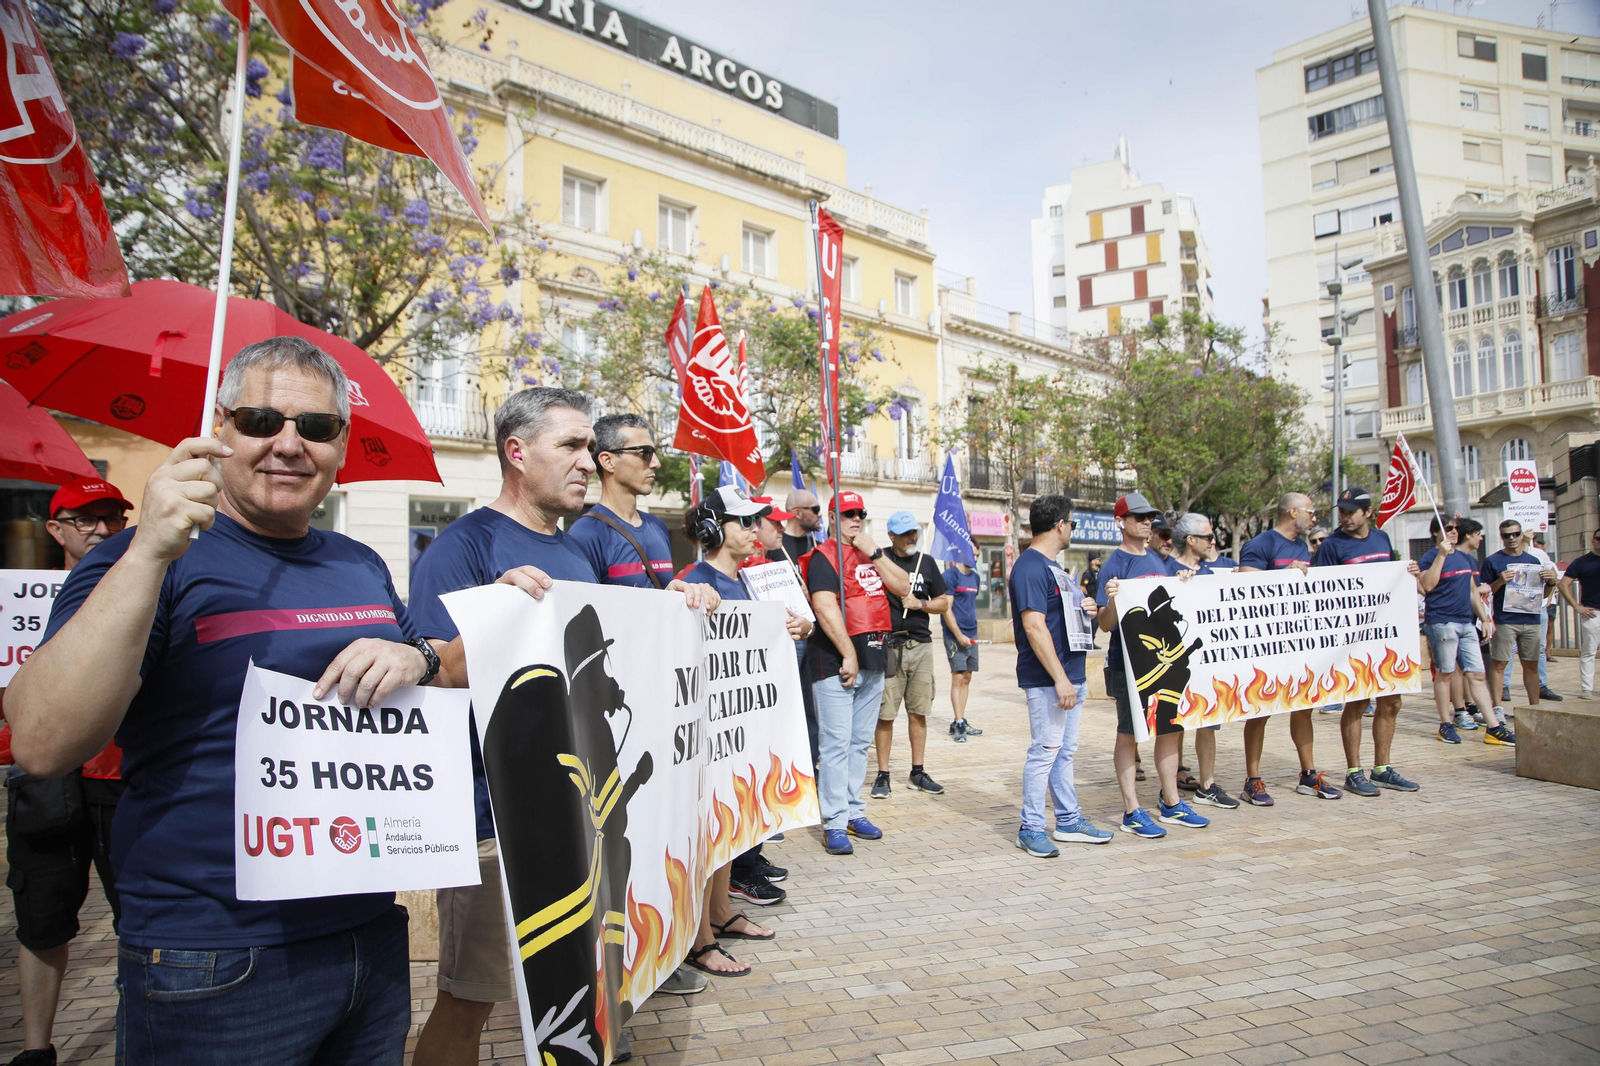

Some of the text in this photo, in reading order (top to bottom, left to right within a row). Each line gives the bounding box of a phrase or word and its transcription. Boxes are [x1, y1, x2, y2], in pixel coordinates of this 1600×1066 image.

[660, 36, 783, 110] ARCOS
[986, 517, 1002, 528] NAILS
[1084, 520, 1120, 532] ALQUIL
[1088, 530, 1099, 540] 98
[1102, 531, 1113, 541] 05
[13, 583, 64, 599] JOR
[1219, 577, 1364, 602] LAS INSTALACIONES
[296, 612, 354, 623] DIGNIDAD
[1196, 591, 1391, 625] DEL PARQUE DE BOMBEROS
[12, 615, 41, 632] 35
[1210, 611, 1377, 644] SON LA VERGÜENZA DEL
[1199, 623, 1399, 665] AYUNTAMIENTO DE ALMERÍA
[674, 665, 699, 708] NO
[745, 648, 768, 675] UN
[708, 682, 778, 723] CALIDAD
[261, 696, 429, 735] JORNADA
[260, 757, 434, 791] 35 HORAS
[383, 816, 421, 828] Almería
[243, 813, 320, 858] UGT
[385, 832, 422, 842] Andalucía
[387, 843, 460, 855] Servicios Públicos
